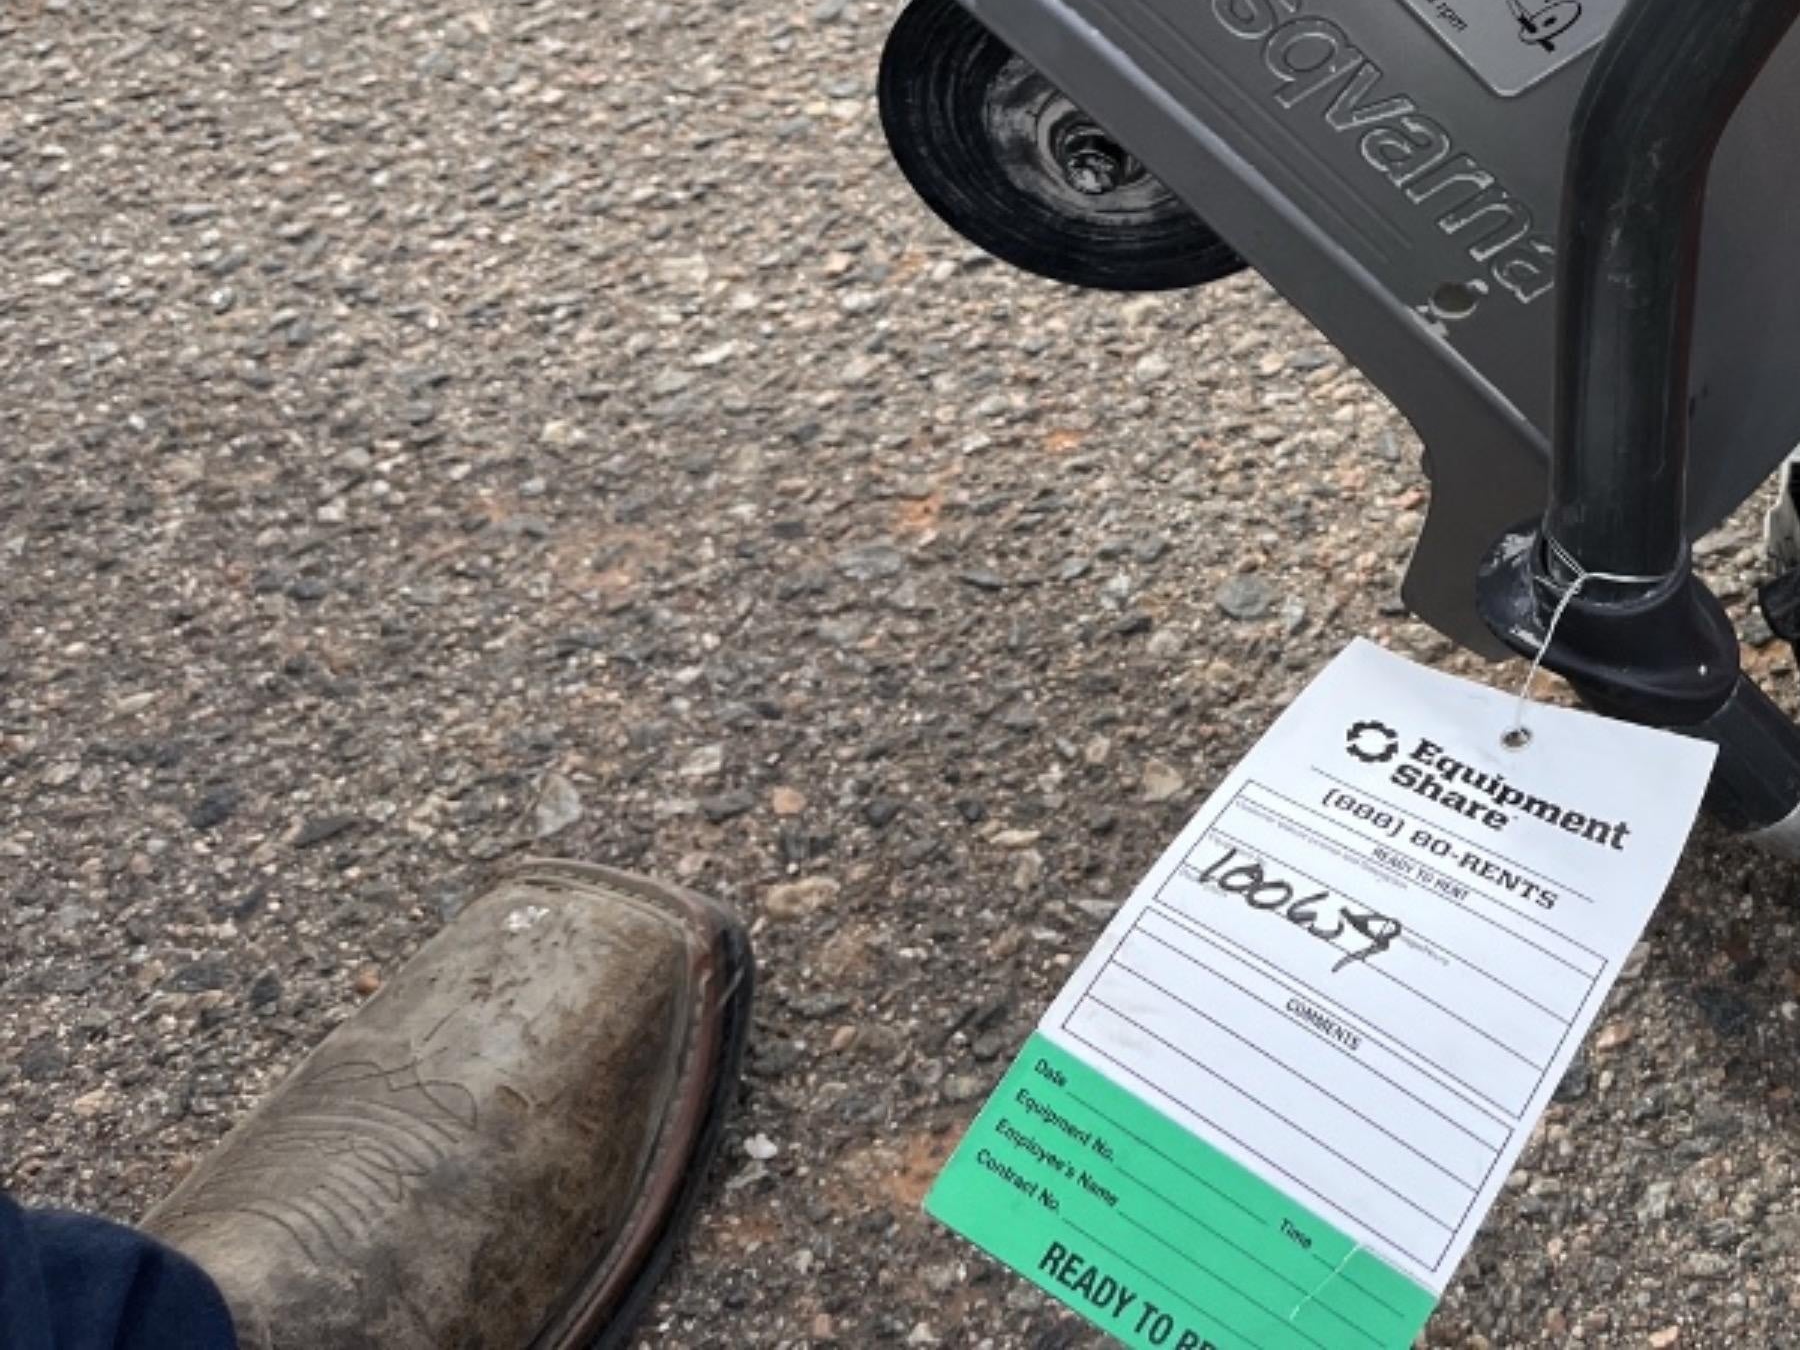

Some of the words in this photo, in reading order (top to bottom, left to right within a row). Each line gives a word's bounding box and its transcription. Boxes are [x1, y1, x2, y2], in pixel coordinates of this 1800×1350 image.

[1436, 2, 1469, 33] rpm
[1389, 763, 1510, 831] Share
[1409, 737, 1631, 851] Equipment
[1322, 788, 1405, 838] (888)
[1410, 830, 1559, 910] 80-RENTS
[1372, 846, 1414, 875] READY
[1415, 867, 1434, 884] TO
[1434, 878, 1470, 901] RENT
[1286, 999, 1362, 1051] COMMENTS
[995, 1118, 1076, 1179] Employee's
[1077, 1170, 1120, 1207] Name
[1015, 1087, 1093, 1146] Equipment
[1092, 1137, 1114, 1163] No.
[1034, 1058, 1068, 1087] Date
[1280, 1218, 1313, 1250] Time
[977, 1148, 1039, 1198] Contract
[1038, 1187, 1061, 1215] No.
[1037, 1241, 1138, 1319] READY
[1134, 1300, 1174, 1346] TO
